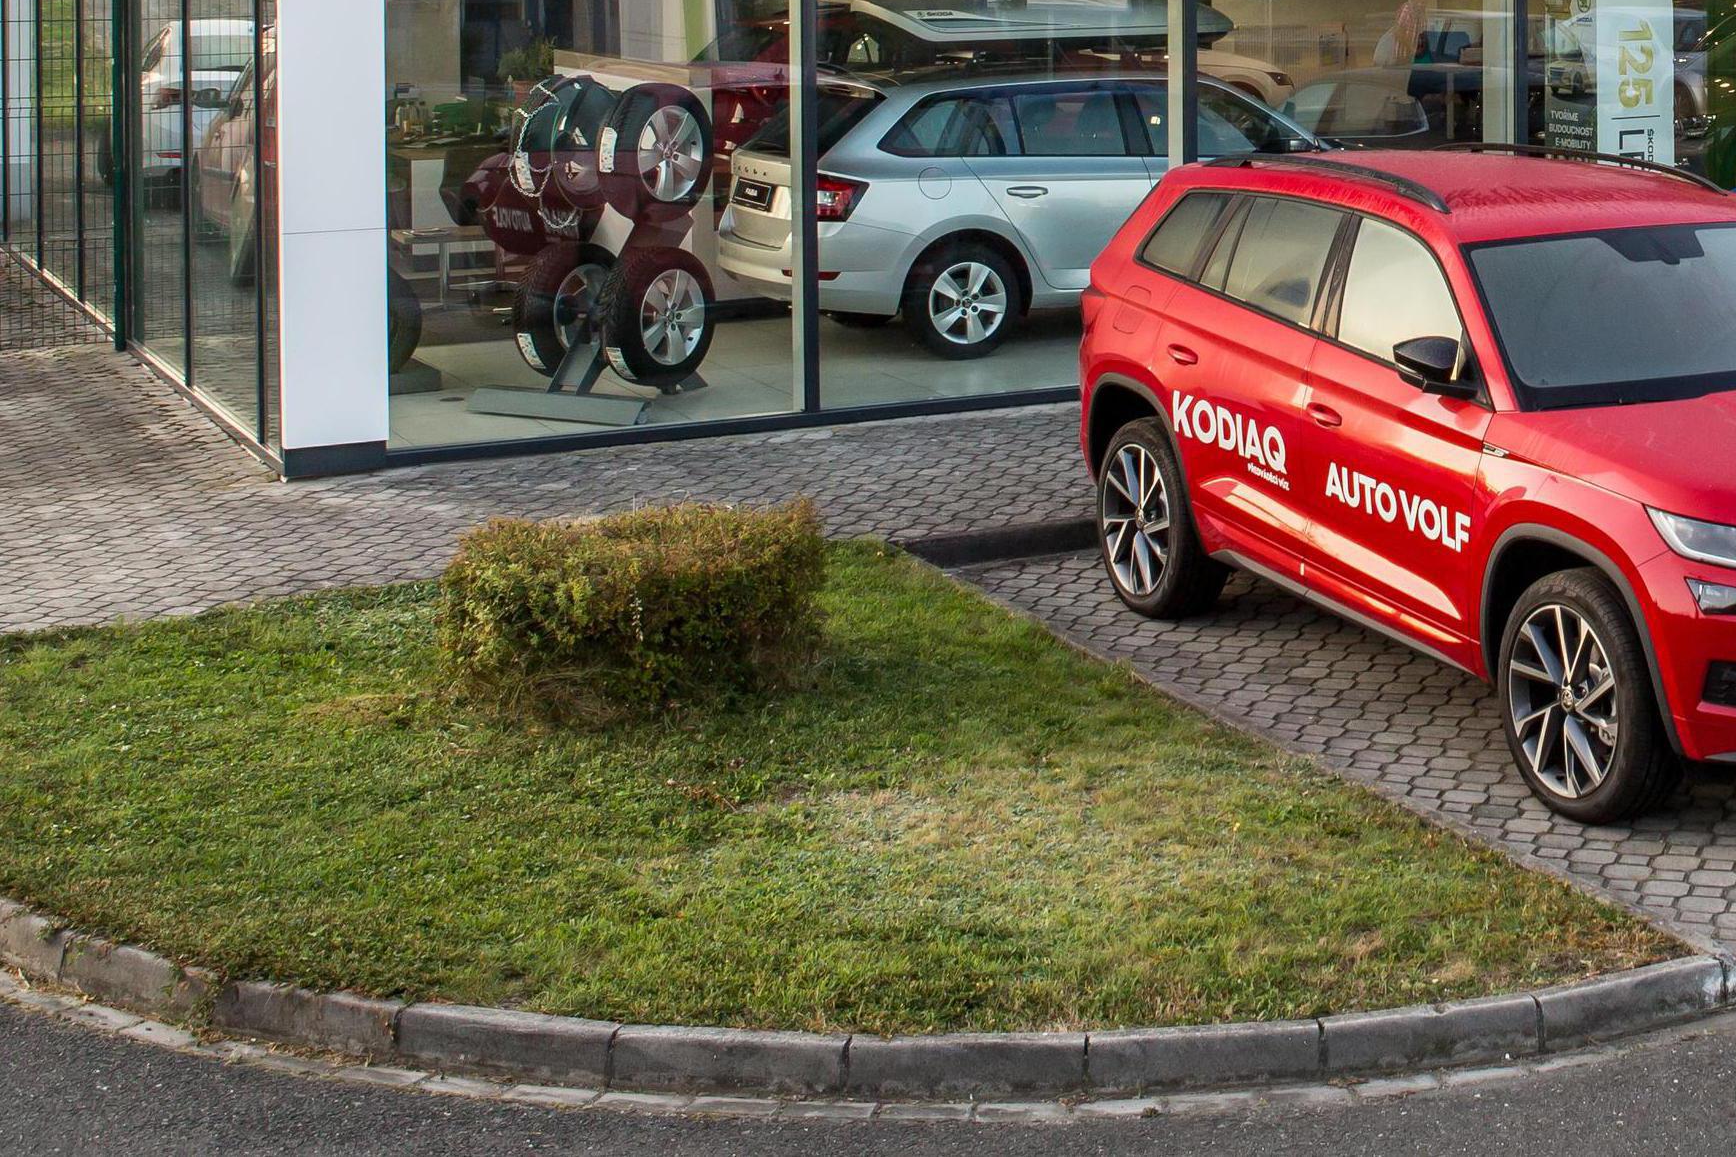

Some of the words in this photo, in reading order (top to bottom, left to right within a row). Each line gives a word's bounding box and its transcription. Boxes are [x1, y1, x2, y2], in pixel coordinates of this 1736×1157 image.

[1618, 20, 1656, 109] 125
[1549, 123, 1594, 137] BUDOUCNOST
[1555, 137, 1592, 150] E-MOBILITY
[1172, 390, 1288, 474] KODIAQ
[1325, 461, 1397, 524] AUTO
[1399, 488, 1471, 553] VOLF
